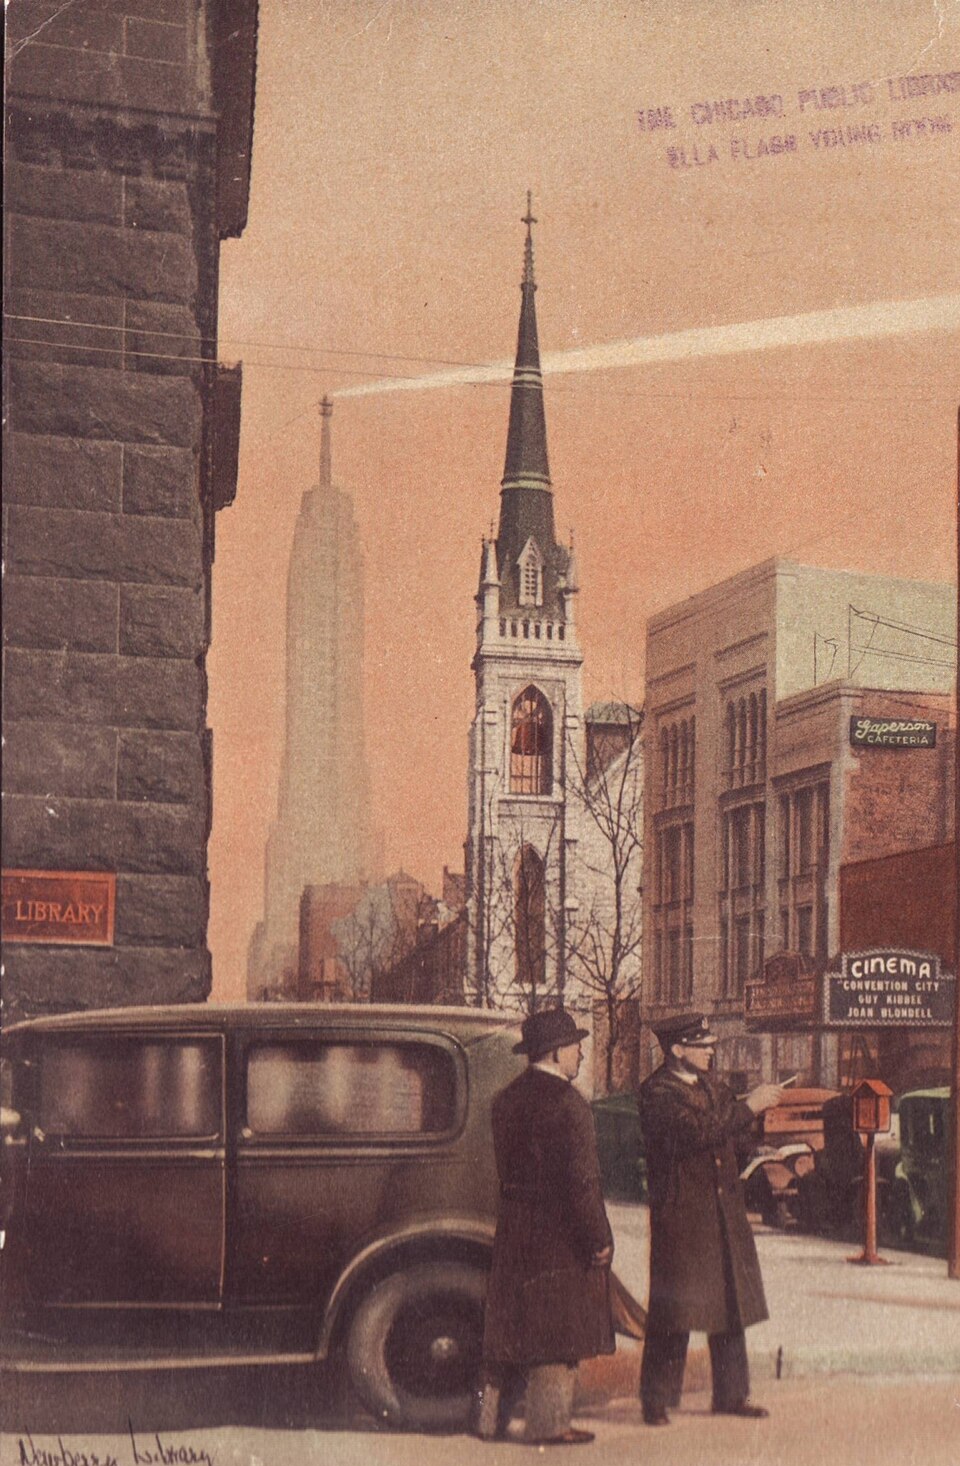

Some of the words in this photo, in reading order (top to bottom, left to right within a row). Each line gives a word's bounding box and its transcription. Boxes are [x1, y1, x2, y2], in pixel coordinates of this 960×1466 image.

[867, 735, 929, 745] CAFETERIA
[15, 900, 103, 924] LIBRARY
[915, 981, 940, 992] CITY
[858, 994, 878, 1005] GUY
[847, 1007, 874, 1018] JOAN
[881, 1007, 933, 1018] BLONDELL
